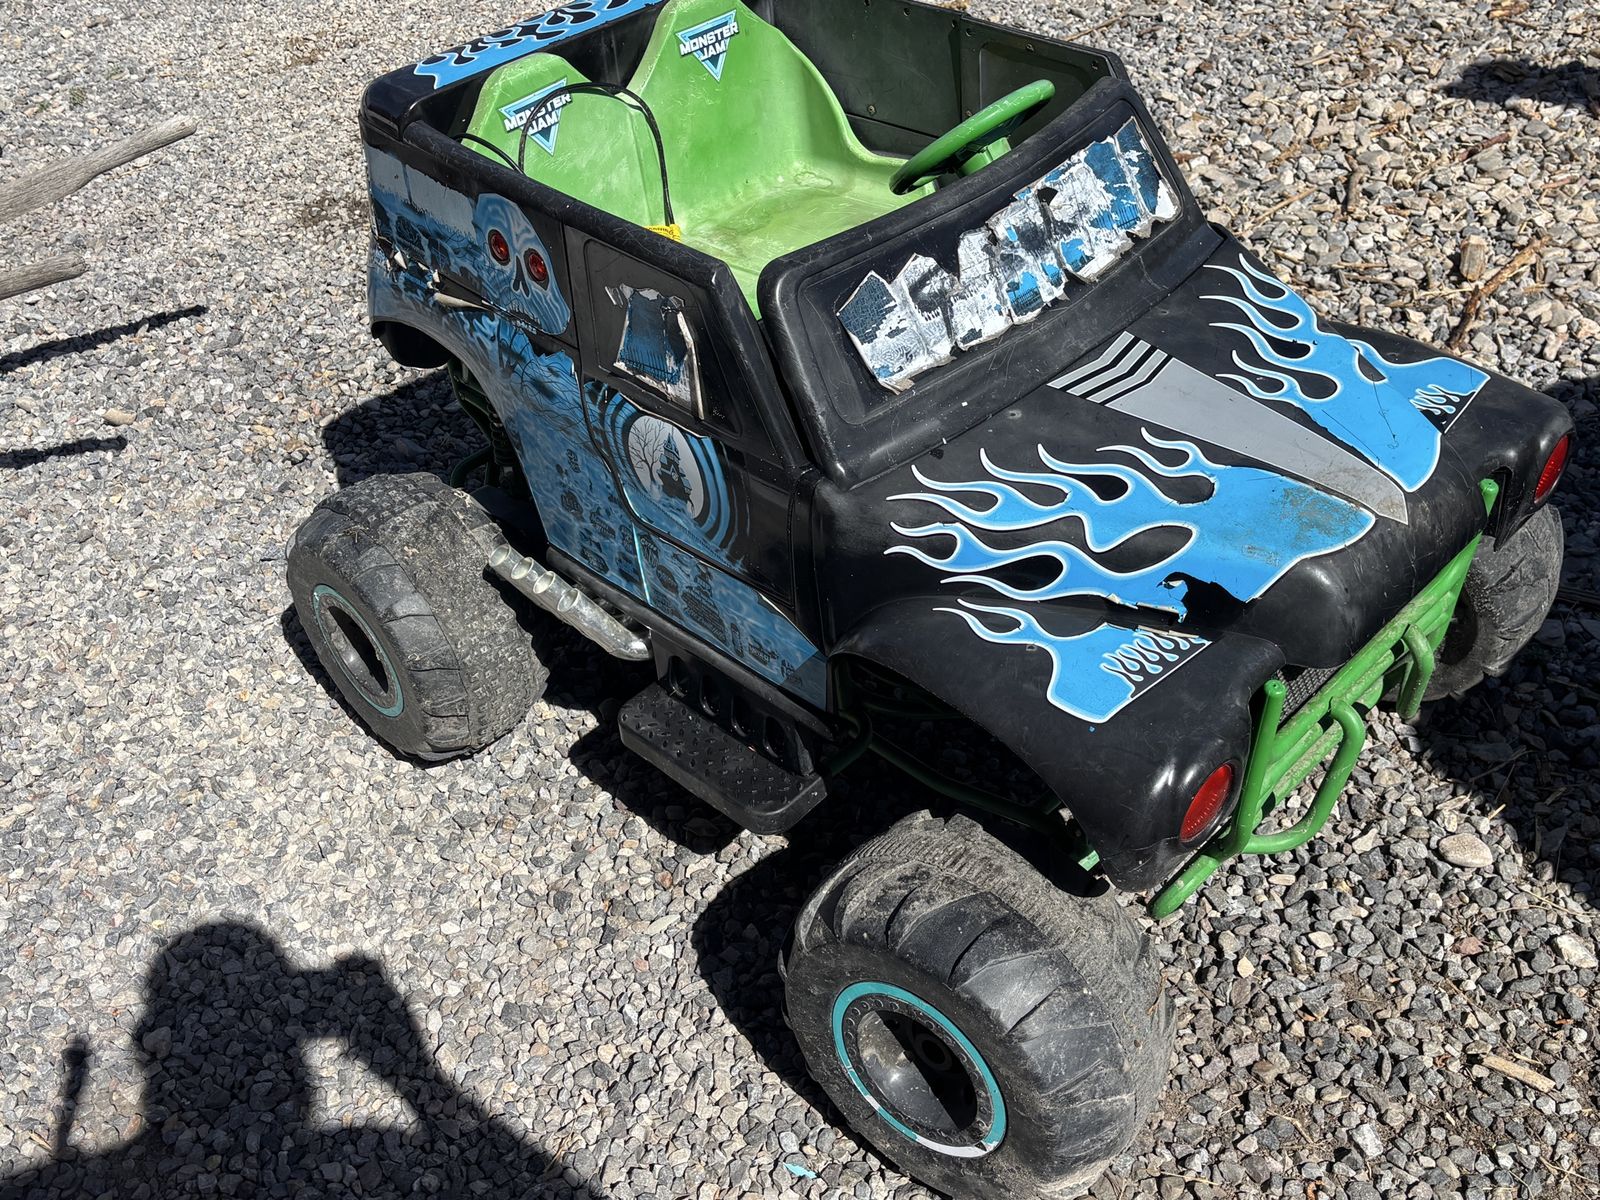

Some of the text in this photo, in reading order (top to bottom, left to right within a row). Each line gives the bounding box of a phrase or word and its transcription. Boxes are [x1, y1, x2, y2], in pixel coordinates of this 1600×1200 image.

[680, 22, 738, 55] MONSTER
[701, 40, 725, 60] JAM
[528, 111, 558, 134] JAM
